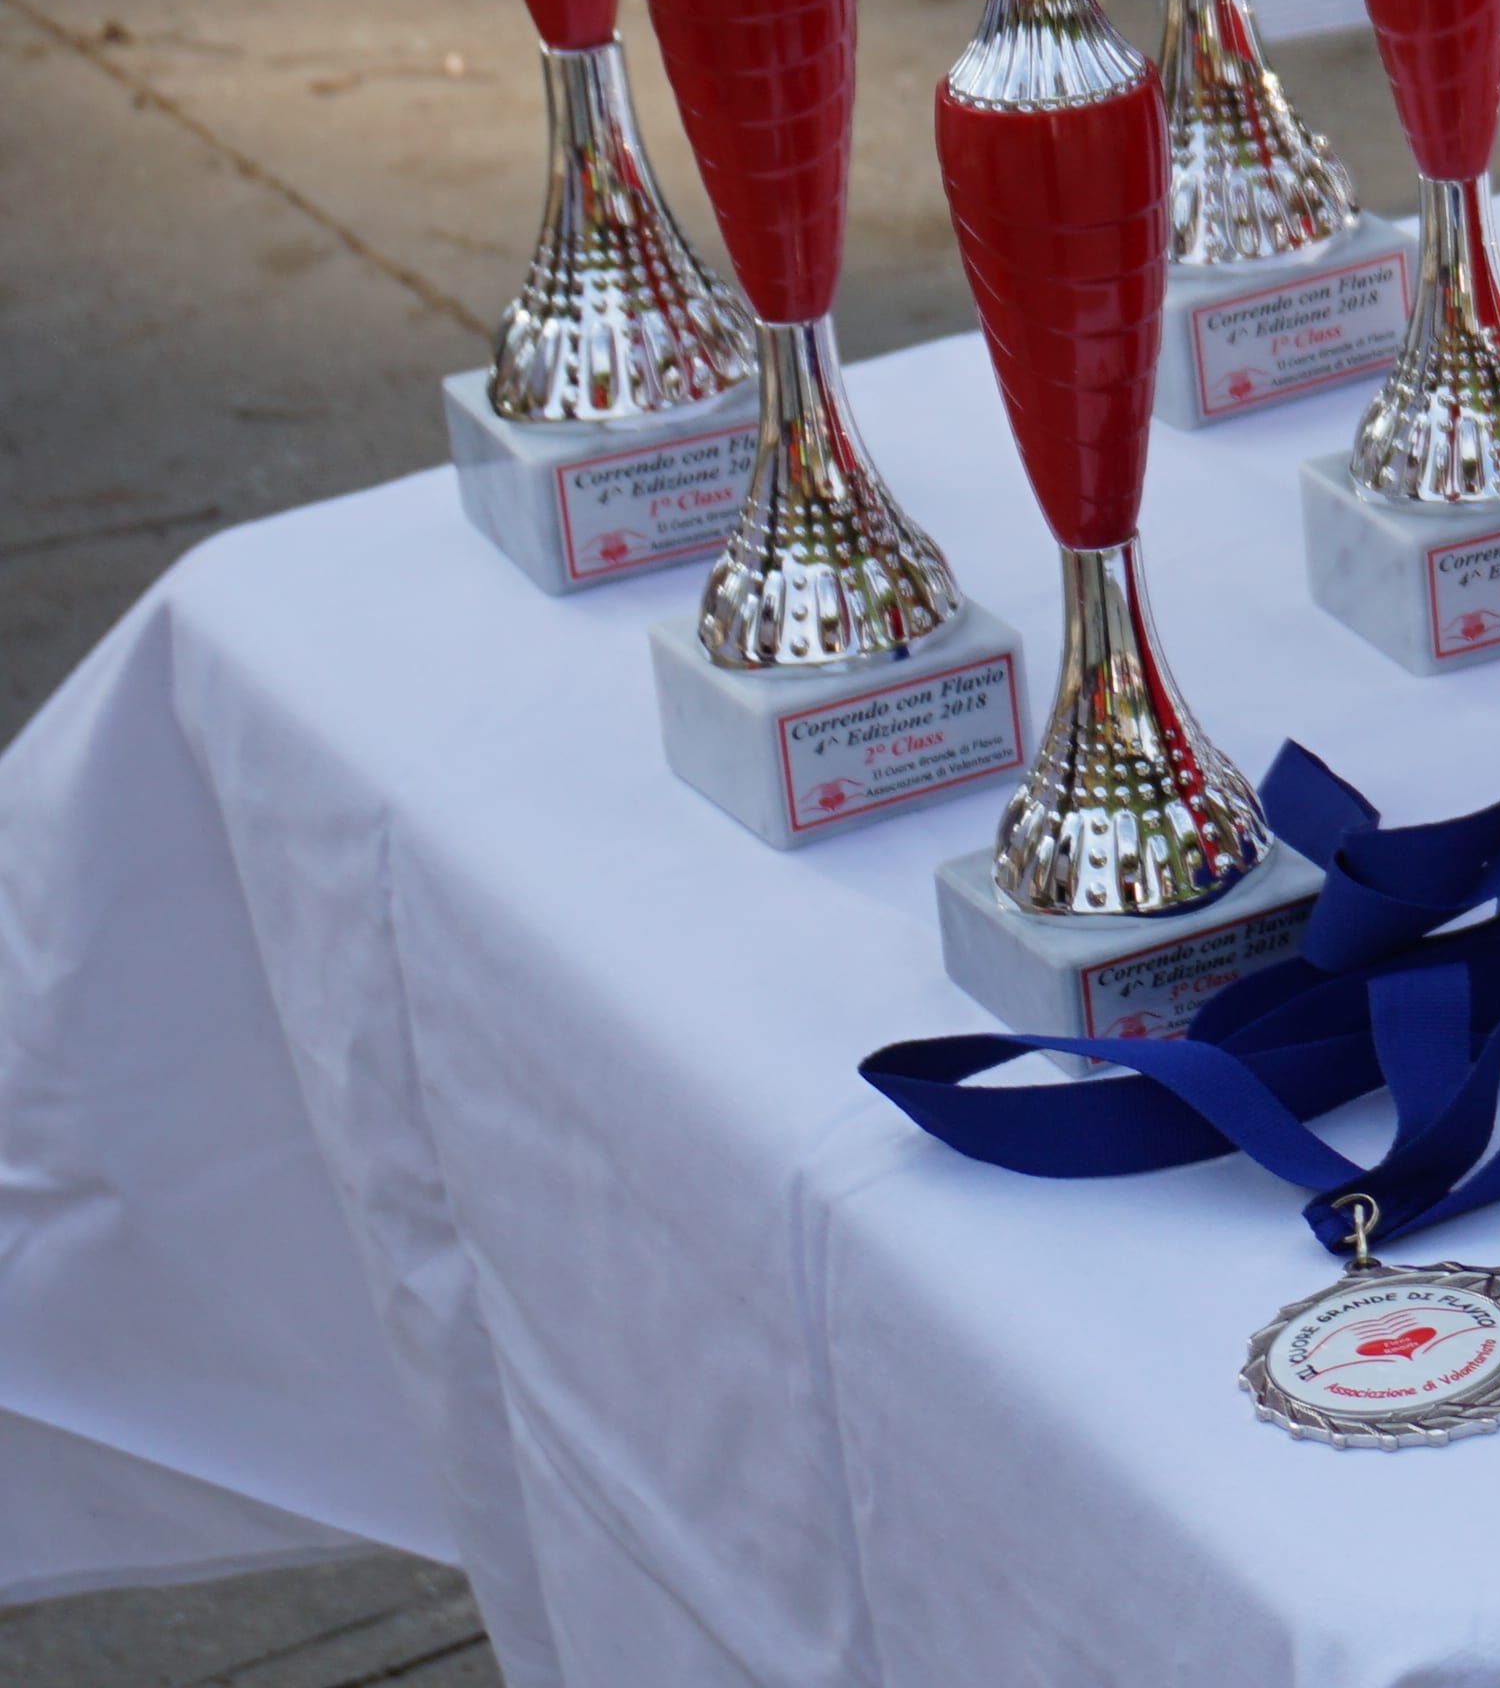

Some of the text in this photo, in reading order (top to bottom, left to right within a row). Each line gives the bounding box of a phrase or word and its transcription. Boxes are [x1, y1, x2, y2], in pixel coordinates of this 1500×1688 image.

[1208, 268, 1393, 331] Correndo con Flavio
[1226, 290, 1379, 345] 4^ Edizione 2018
[1270, 325, 1343, 355] 1° Class
[575, 446, 719, 489] Correndo con
[633, 466, 720, 497] Edizione
[678, 487, 733, 511] Class
[1459, 570, 1481, 587] 4^
[791, 667, 1004, 741] Correndo con Flavio
[814, 692, 988, 755] 4^ Edizione 2018
[864, 731, 944, 765] 2° Class
[886, 760, 915, 777] Cuore
[919, 751, 956, 768] Grande
[960, 745, 969, 755] di
[973, 736, 1003, 750] Flavio
[865, 749, 1014, 798] Associazione di Volontariato
[1097, 943, 1195, 987] Correndo
[1201, 933, 1236, 953] con
[1119, 932, 1290, 998] 4^ Edizione 2018
[1193, 969, 1240, 993] Class
[1288, 1292, 1496, 1381] IL CUORE GRANDE DI FLAVIO
[1324, 1382, 1417, 1399] Associazione
[1423, 1380, 1436, 1392] di
[1440, 1338, 1496, 1385] Volontariato
